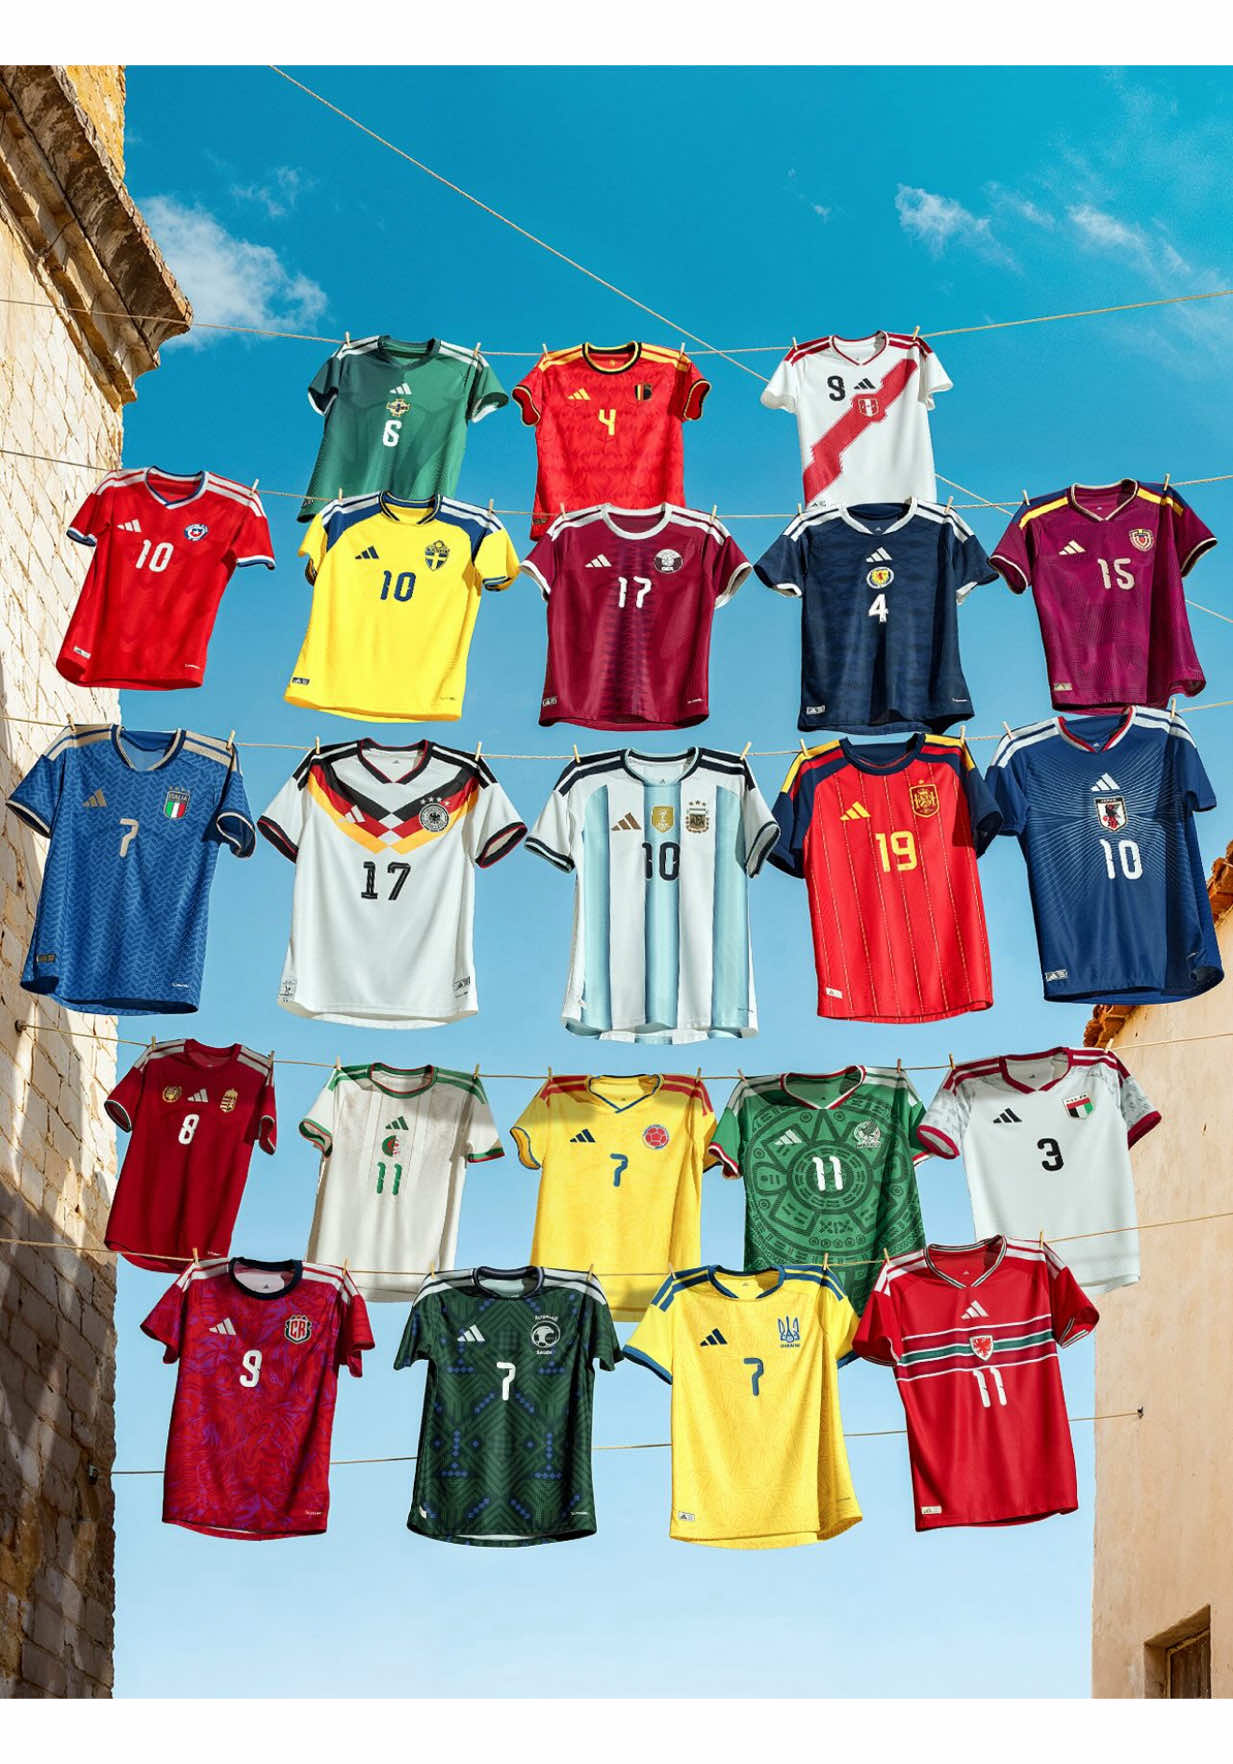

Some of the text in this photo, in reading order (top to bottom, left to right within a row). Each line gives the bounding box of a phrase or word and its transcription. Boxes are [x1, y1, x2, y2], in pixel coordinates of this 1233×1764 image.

[827, 376, 846, 402] 9
[383, 420, 401, 447] 6
[599, 409, 616, 435] 4
[136, 540, 173, 572] 10
[381, 570, 416, 602] 10
[1098, 558, 1135, 590] 15
[619, 576, 651, 608] 17
[869, 594, 888, 623] 4
[120, 818, 139, 857] 7
[876, 831, 917, 872] 19
[642, 841, 680, 881] 10
[1100, 839, 1142, 880] 10
[361, 861, 411, 900] 17
[179, 1114, 200, 1145] 8
[610, 1154, 628, 1187] 7
[1037, 1138, 1064, 1171] 3
[377, 1162, 402, 1195] 11
[813, 1156, 843, 1191] 11
[291, 1321, 306, 1339] CR
[240, 1350, 262, 1387] 9
[497, 1362, 515, 1400] 7
[744, 1358, 764, 1396] 7
[973, 1367, 1007, 1407] 11
